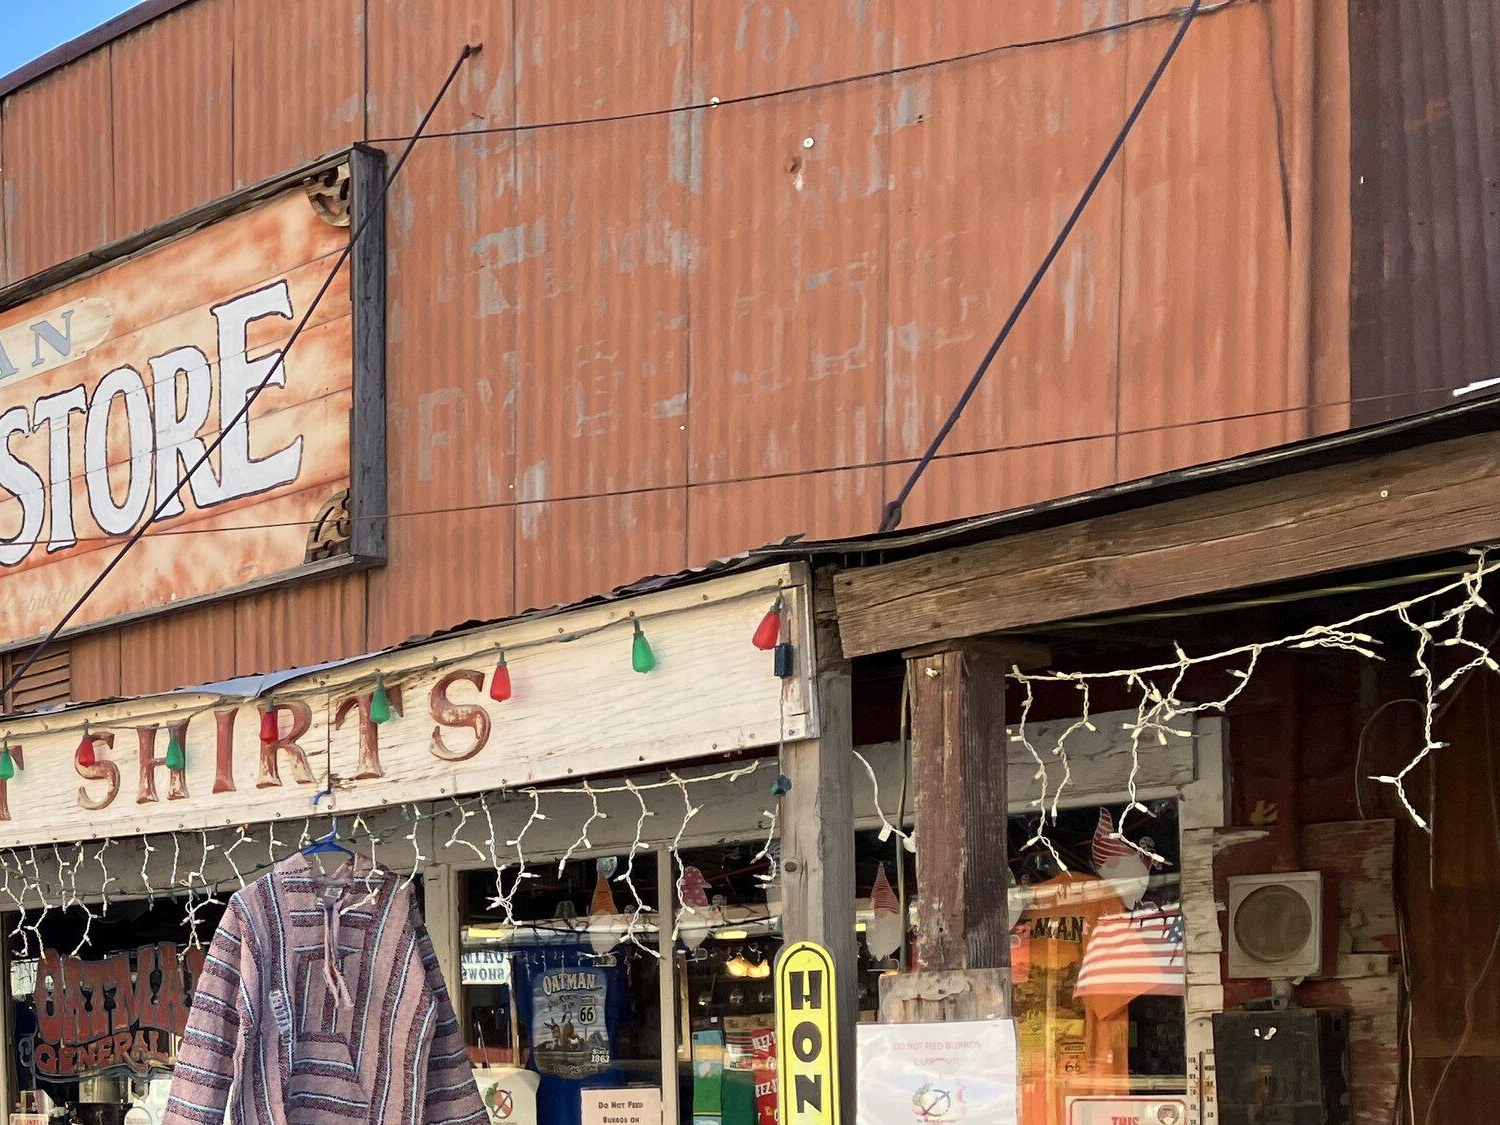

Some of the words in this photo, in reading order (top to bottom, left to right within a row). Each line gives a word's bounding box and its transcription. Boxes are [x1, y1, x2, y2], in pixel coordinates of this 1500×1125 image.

[75, 669, 491, 810] SHIRTS
[543, 972, 596, 996] OATMAN
[580, 1006, 594, 1022] 66
[35, 1030, 171, 1076] GENERAL
[893, 1042, 905, 1051] DO
[907, 1042, 923, 1050] NOT
[925, 1041, 943, 1050] FEED
[945, 1040, 981, 1050] BURROS
[598, 1101, 609, 1109] DO
[611, 1101, 625, 1109] NOT
[628, 1101, 644, 1109] FEED
[603, 1116, 628, 1124] BURROS
